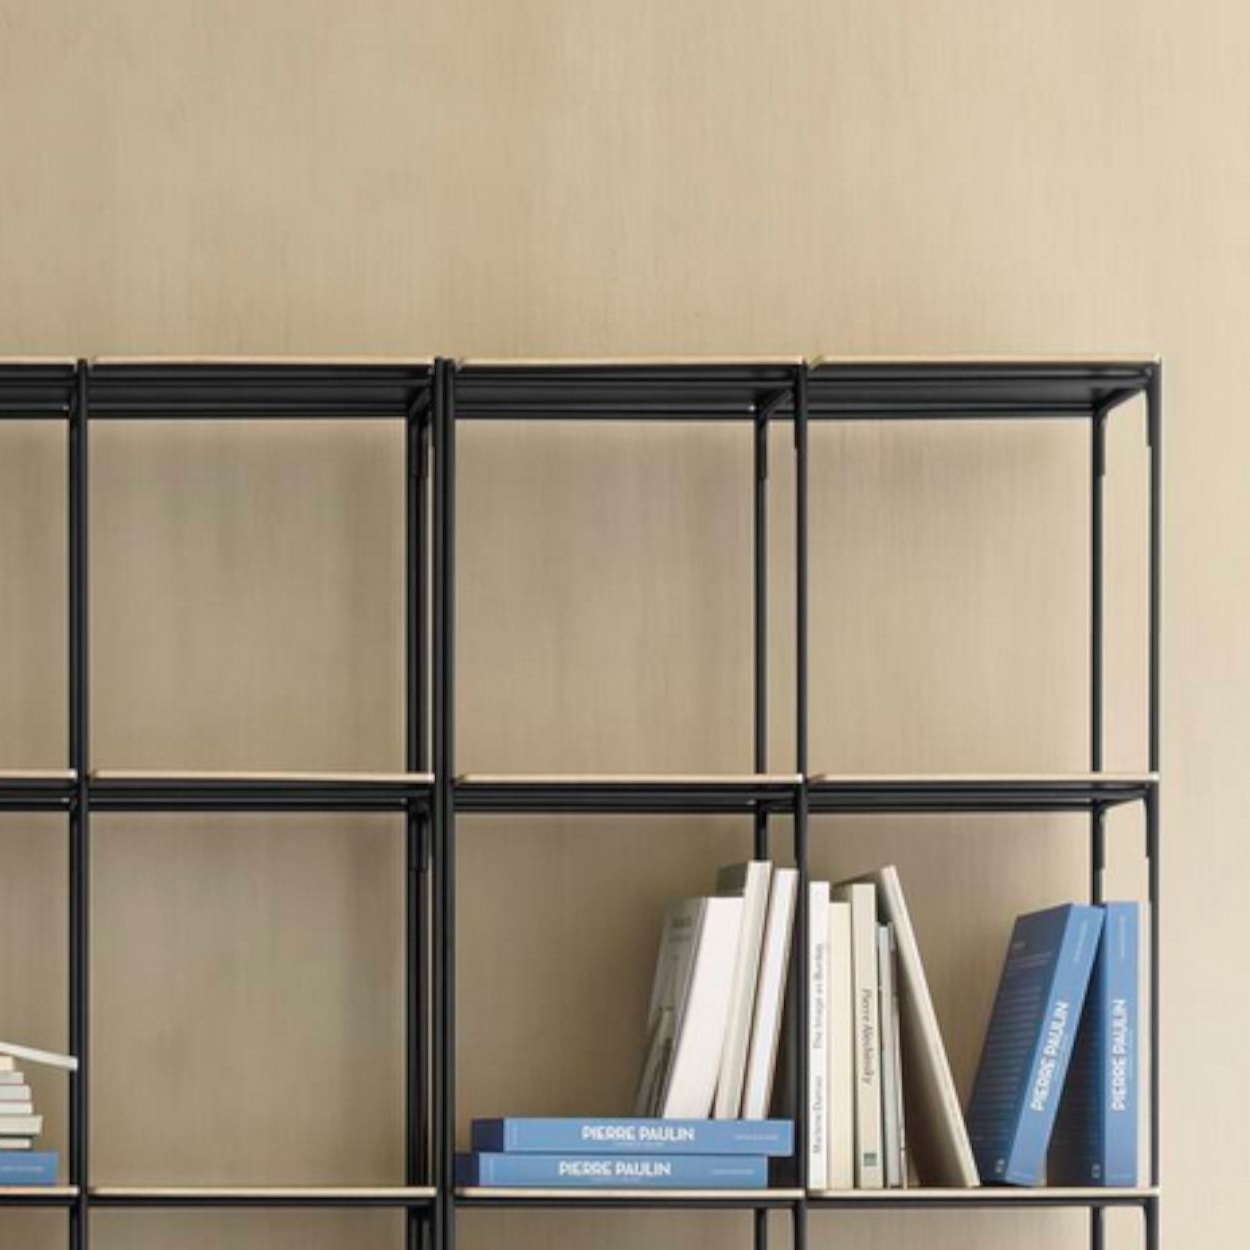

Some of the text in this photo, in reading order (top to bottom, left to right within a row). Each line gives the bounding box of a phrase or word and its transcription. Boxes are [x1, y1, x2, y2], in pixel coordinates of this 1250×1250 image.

[1030, 1001, 1069, 1112] PIERRE PAULIN
[1111, 998, 1127, 1111] PIERRE PAULIN
[581, 1124, 696, 1141] PIERRE PAULIN
[558, 1160, 672, 1176] PIERRE PAULIN
